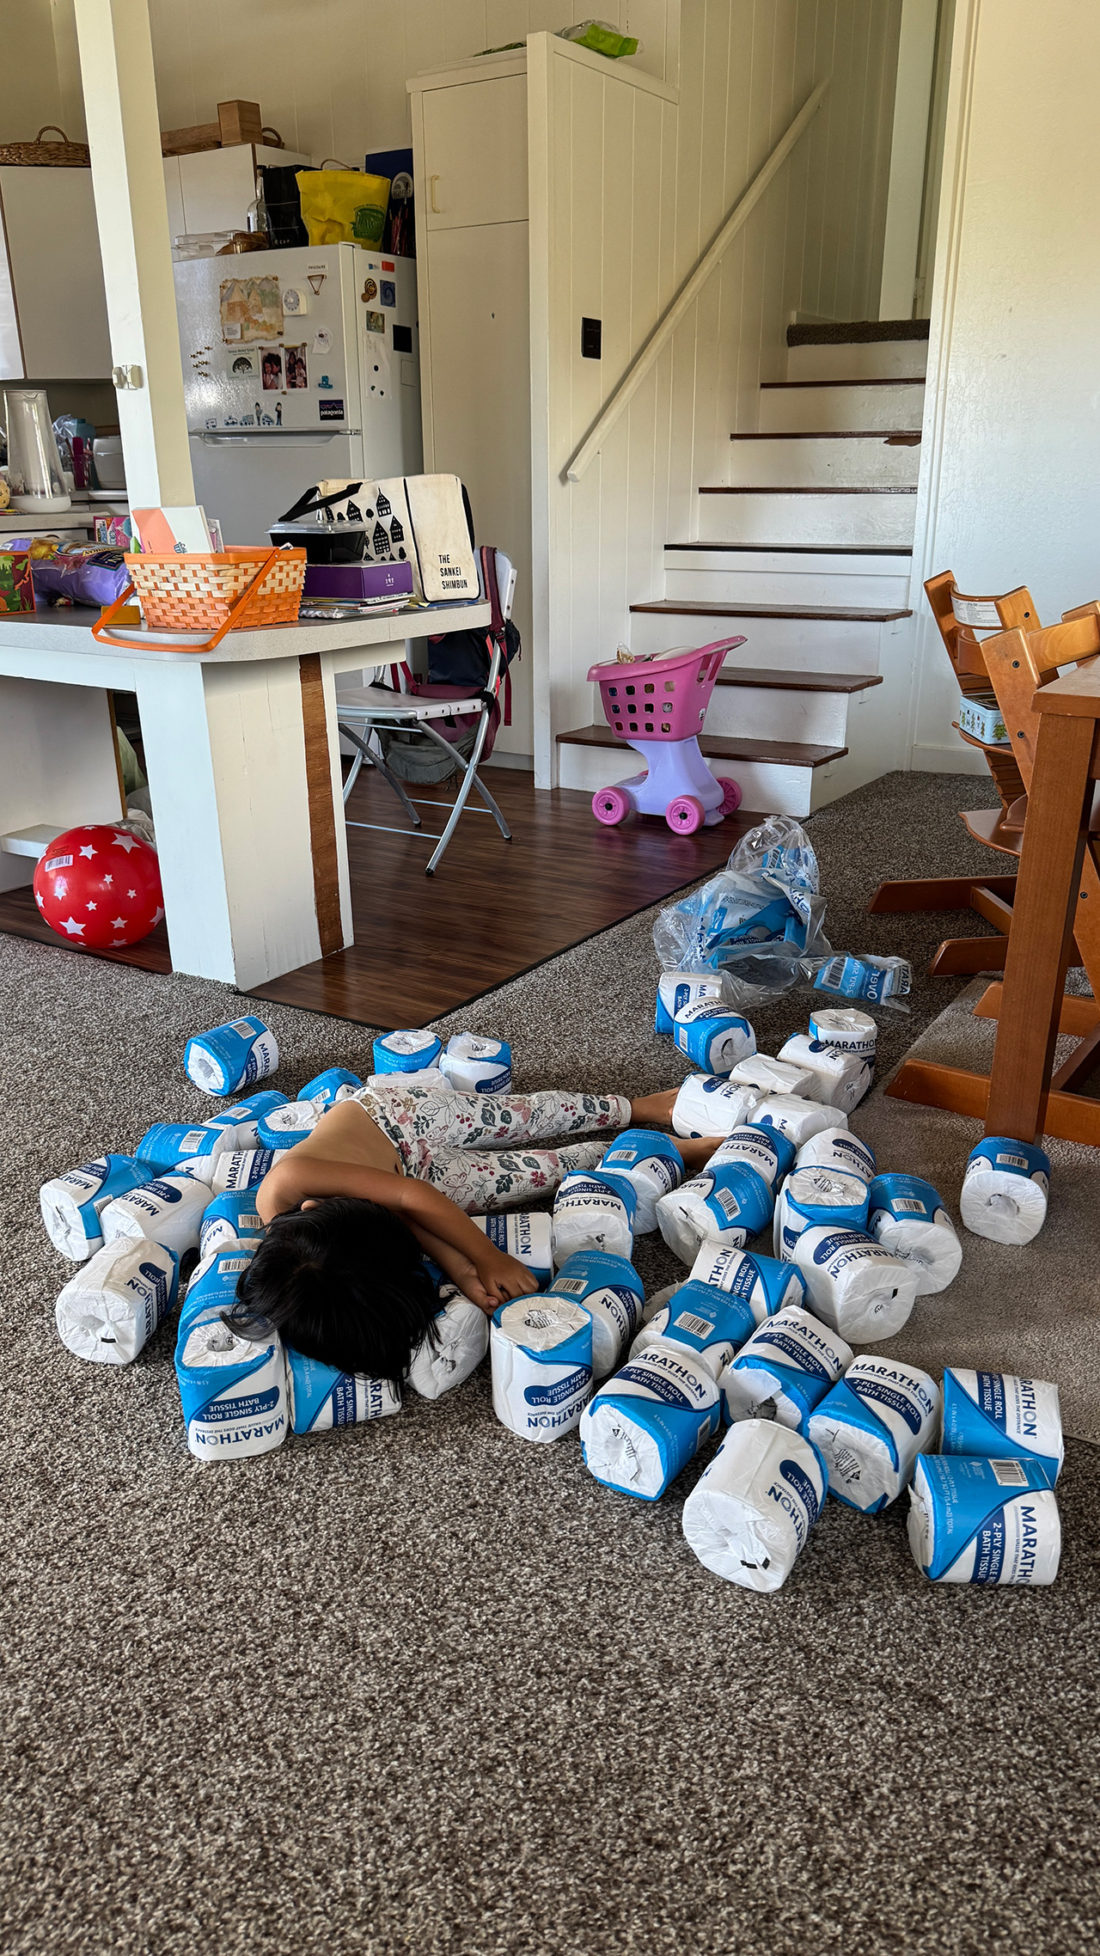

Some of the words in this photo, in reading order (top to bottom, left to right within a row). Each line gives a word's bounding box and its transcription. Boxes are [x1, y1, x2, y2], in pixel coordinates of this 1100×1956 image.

[438, 554, 451, 564] THE
[440, 566, 461, 577] SANKEI
[442, 579, 468, 590] SHIMBUN
[825, 1039, 876, 1050] MARATHO
[226, 1150, 245, 1189] MARATH
[820, 1245, 835, 1260] ROLL
[739, 1263, 751, 1277] ROLL
[744, 1269, 756, 1292] TISSUE
[772, 1339, 792, 1352] BATH
[792, 1352, 815, 1372] TISSUE
[784, 1337, 809, 1357] SINGLE
[808, 1355, 824, 1374] ROLL
[336, 1387, 345, 1406] BATH
[345, 1378, 353, 1398] 2-PLY
[547, 1383, 570, 1396] TISSUE
[554, 1386, 575, 1403] SINGLE
[630, 1374, 650, 1385] BATH
[650, 1382, 675, 1402] TISSUE
[642, 1371, 667, 1386] SINGLE
[667, 1385, 684, 1402] ROLL
[852, 1364, 934, 1414] MARATHON
[209, 1402, 236, 1412] TISSUE
[238, 1397, 260, 1408] BATH
[254, 1400, 275, 1413] 2-PLY
[531, 1396, 551, 1404] ROLL
[853, 1380, 877, 1388] 2-PLY
[877, 1385, 906, 1403] SINGLE
[905, 1403, 920, 1424] ROLL
[856, 1386, 879, 1396] BATH
[879, 1394, 908, 1414] TISSUE
[983, 1391, 992, 1411] TISSUE
[994, 1400, 1003, 1419] ROLL
[1020, 1380, 1037, 1436] RATHON
[224, 1407, 253, 1419] SINGLE
[337, 1407, 345, 1425] TISSU
[346, 1400, 354, 1422] SINGLE
[195, 1414, 285, 1446] MARATHON
[787, 1471, 803, 1492] ROLL
[981, 1530, 991, 1554] BATH
[992, 1522, 1002, 1547] 2-PLY
[1016, 1506, 1037, 1584] MARATHO
[977, 1556, 990, 1579] TISSUE
[989, 1549, 1000, 1575] SINGLE
